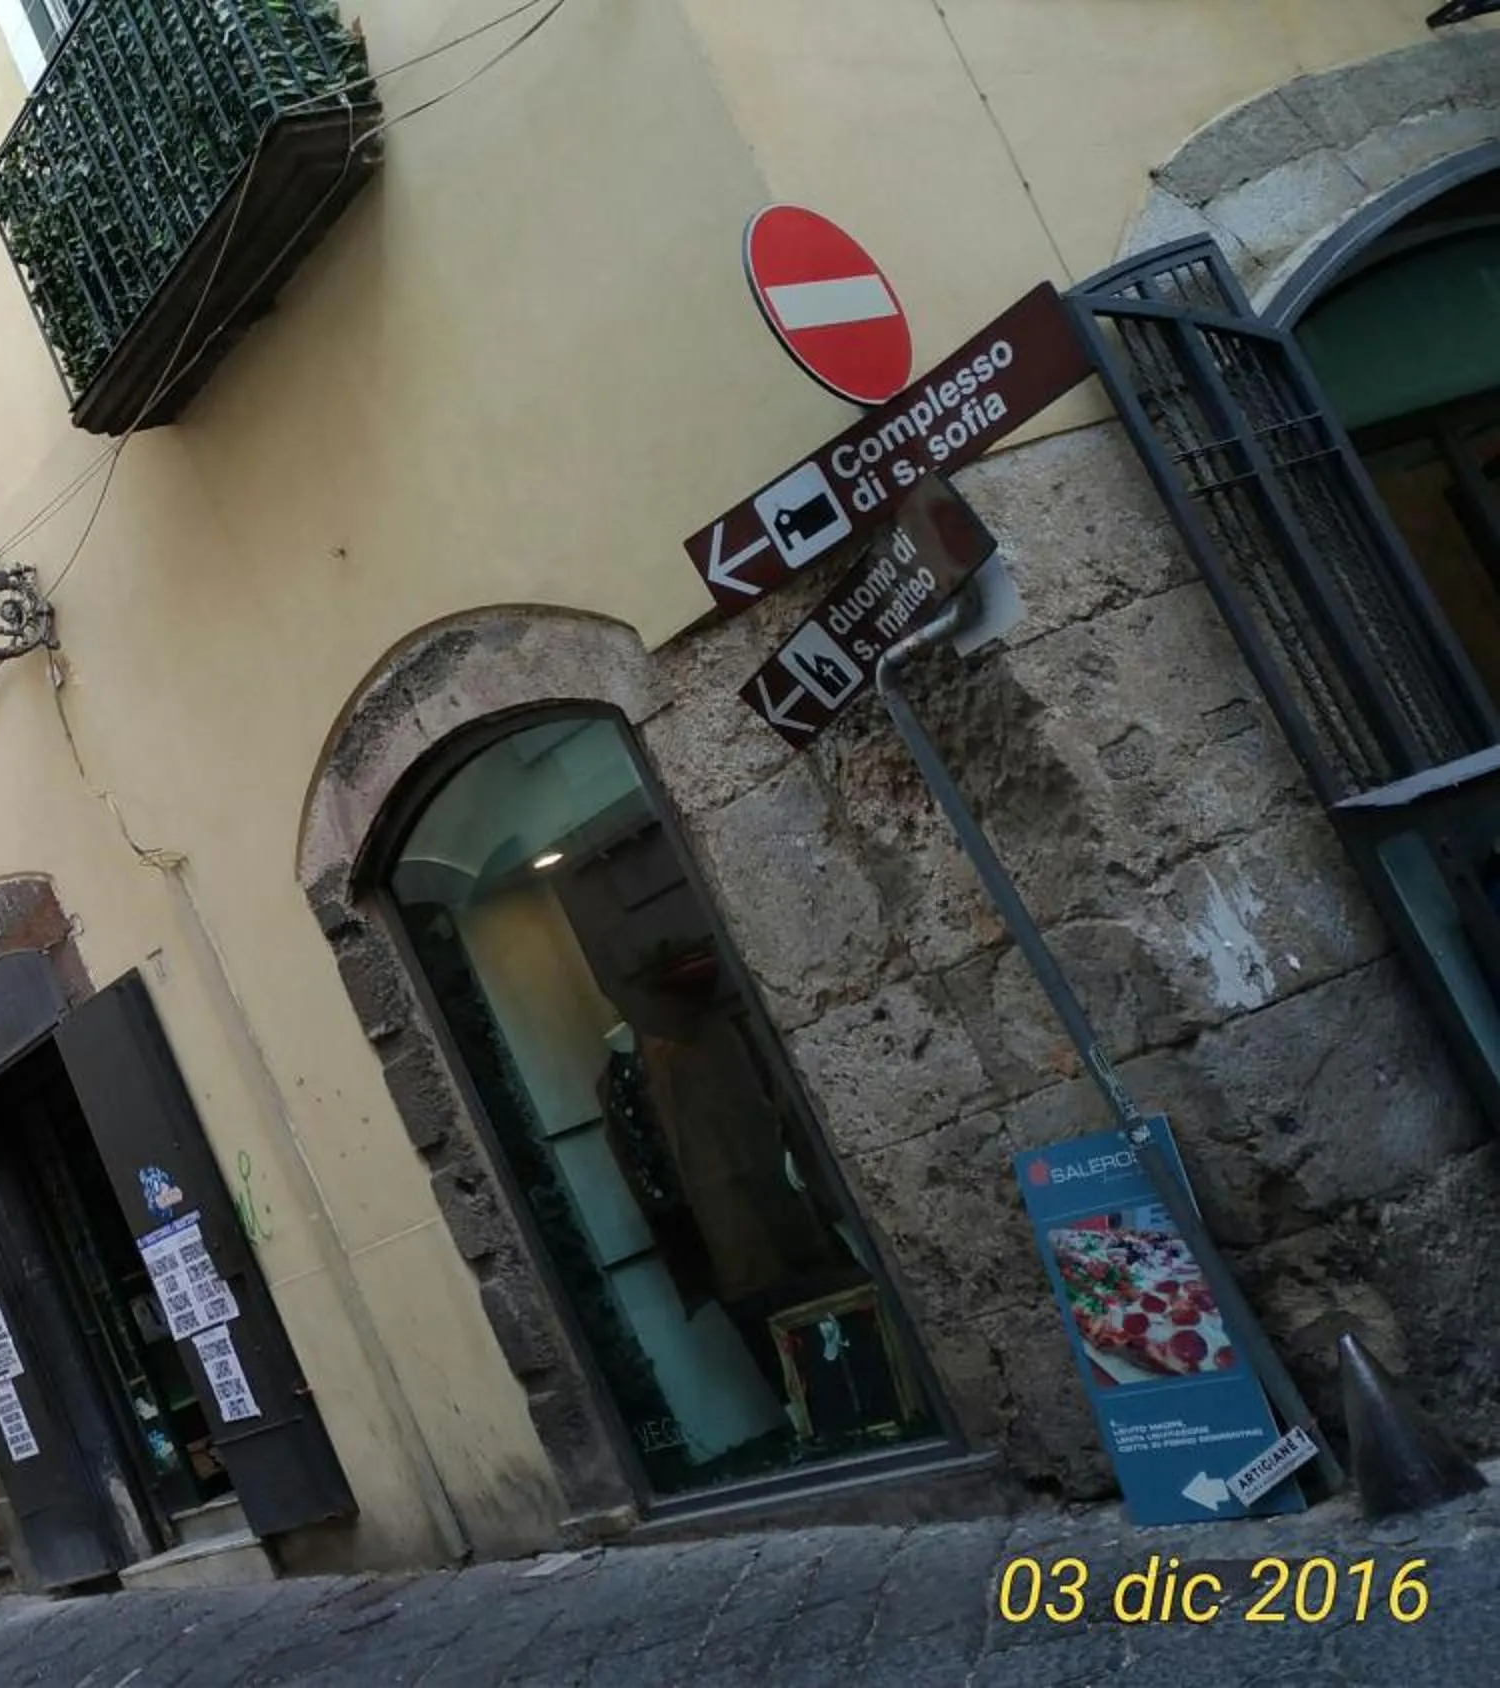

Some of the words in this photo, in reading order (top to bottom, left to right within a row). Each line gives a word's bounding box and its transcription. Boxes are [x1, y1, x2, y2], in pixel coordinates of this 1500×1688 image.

[831, 339, 1013, 479] Complesso
[852, 470, 888, 513] di
[892, 458, 927, 486] s.
[928, 391, 1008, 462] sofia
[827, 556, 897, 636] duomo
[892, 527, 918, 564] di
[852, 637, 881, 662] s.
[874, 566, 936, 640] matteo
